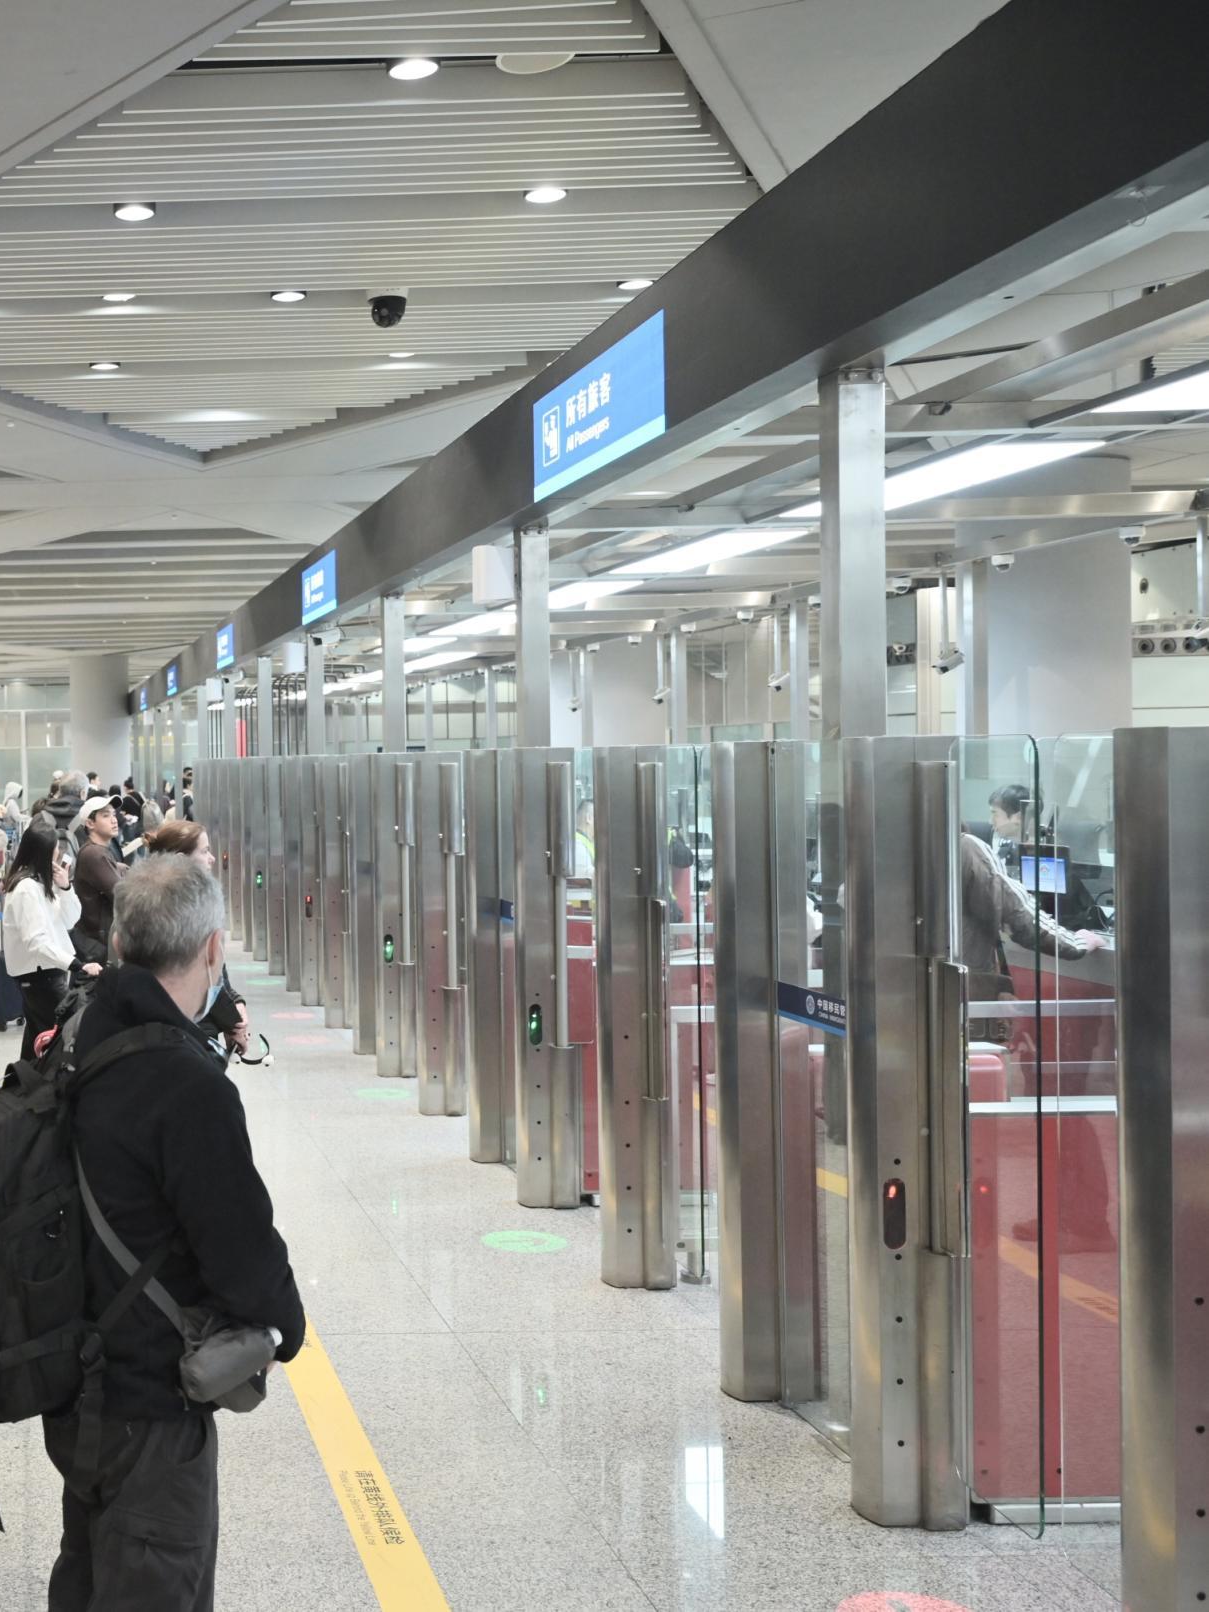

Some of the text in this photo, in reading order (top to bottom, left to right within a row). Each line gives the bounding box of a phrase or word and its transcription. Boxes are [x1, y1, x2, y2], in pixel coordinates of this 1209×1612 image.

[566, 372, 610, 428] 所有旅客
[566, 416, 610, 453] All Passengers
